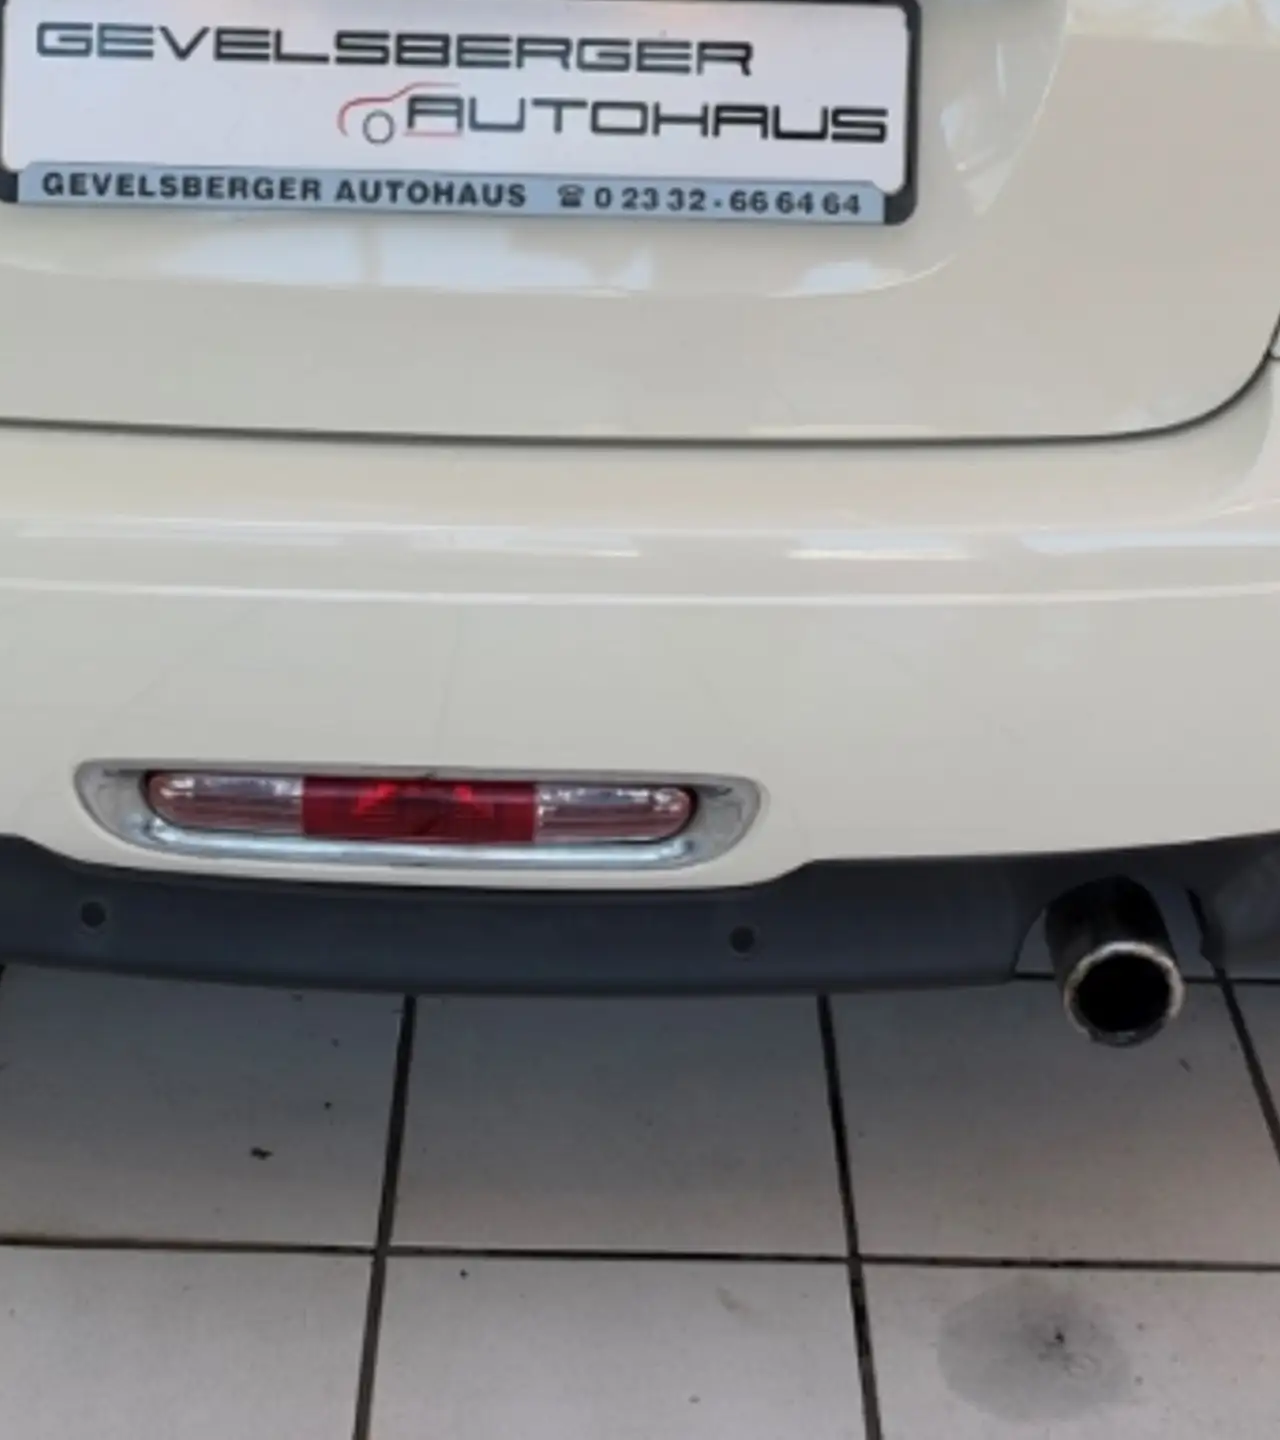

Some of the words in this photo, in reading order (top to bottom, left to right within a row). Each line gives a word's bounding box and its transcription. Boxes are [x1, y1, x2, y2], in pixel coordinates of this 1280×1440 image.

[36, 22, 754, 76] GEVELSBERGER
[406, 94, 888, 144] AUTOHAUS
[43, 172, 322, 201] GEVELSBERGER
[335, 179, 527, 208] AUTOHAUS
